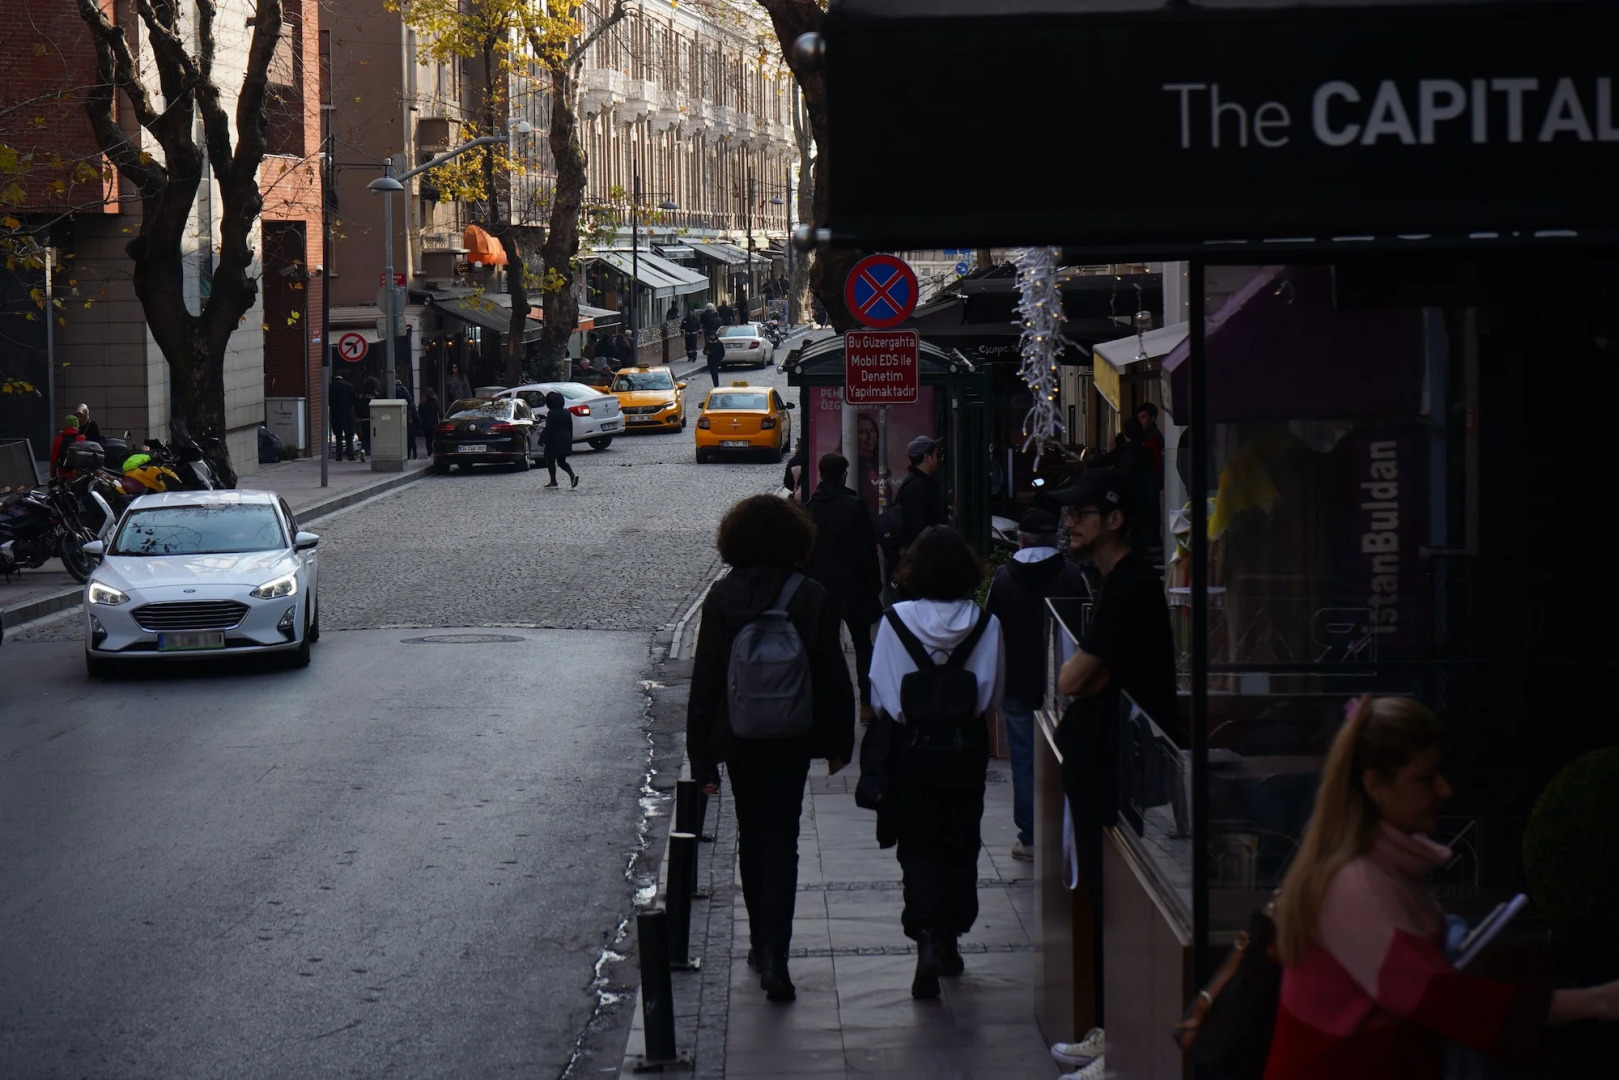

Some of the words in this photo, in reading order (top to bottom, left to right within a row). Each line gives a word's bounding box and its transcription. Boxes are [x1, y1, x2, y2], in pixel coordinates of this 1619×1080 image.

[1161, 82, 1292, 149] The
[1310, 76, 1619, 147] CAPITAL
[848, 336, 861, 348] Bu
[862, 335, 915, 350] Güzergahta
[851, 354, 877, 367] Mobil
[879, 354, 899, 366] EDS
[900, 353, 912, 366] ile
[861, 370, 903, 382] Denetim
[848, 384, 916, 400] Yapılmaktadır
